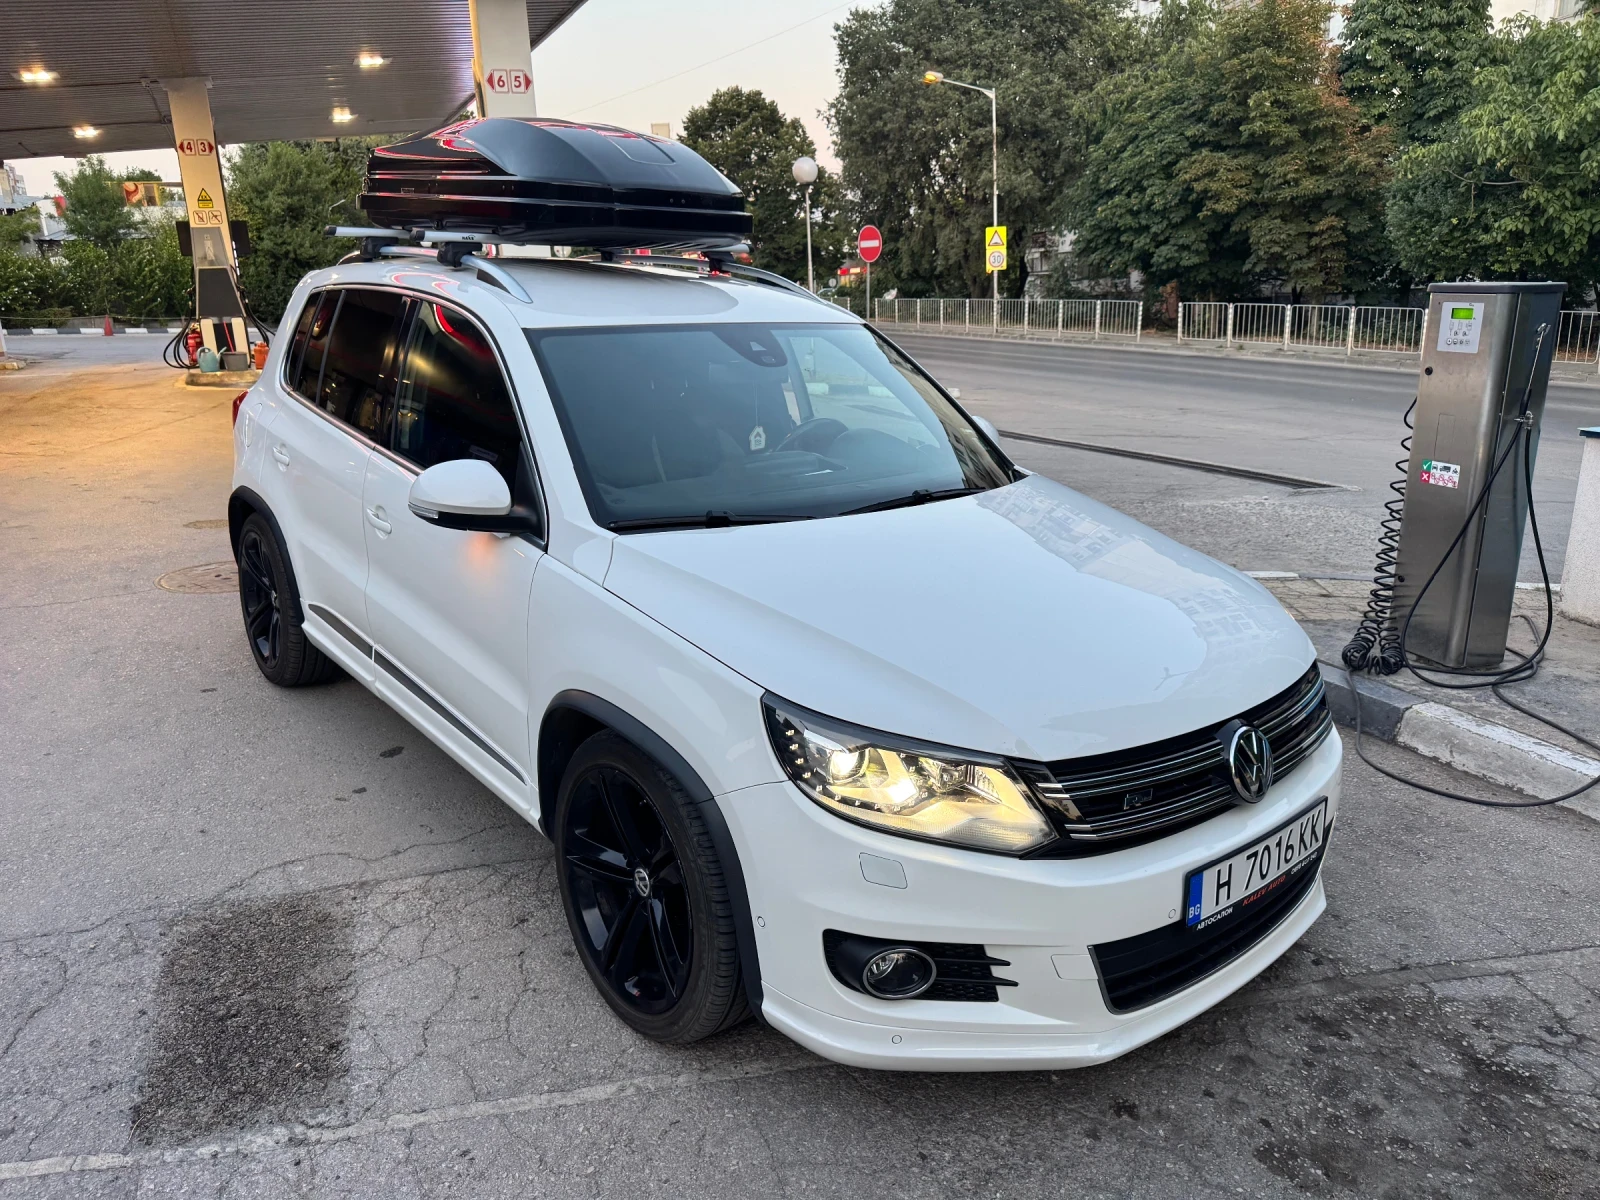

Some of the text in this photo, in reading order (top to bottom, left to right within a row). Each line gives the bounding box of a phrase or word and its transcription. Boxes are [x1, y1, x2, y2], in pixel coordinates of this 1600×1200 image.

[497, 75, 522, 89] 6 5
[186, 141, 207, 153] 4 3
[992, 255, 1001, 264] 30
[1214, 862, 1233, 907] H
[1242, 874, 1286, 907] KALEV AUTO
[1188, 903, 1201, 919] BG
[1196, 906, 1234, 931] АВТОСАЛОН
